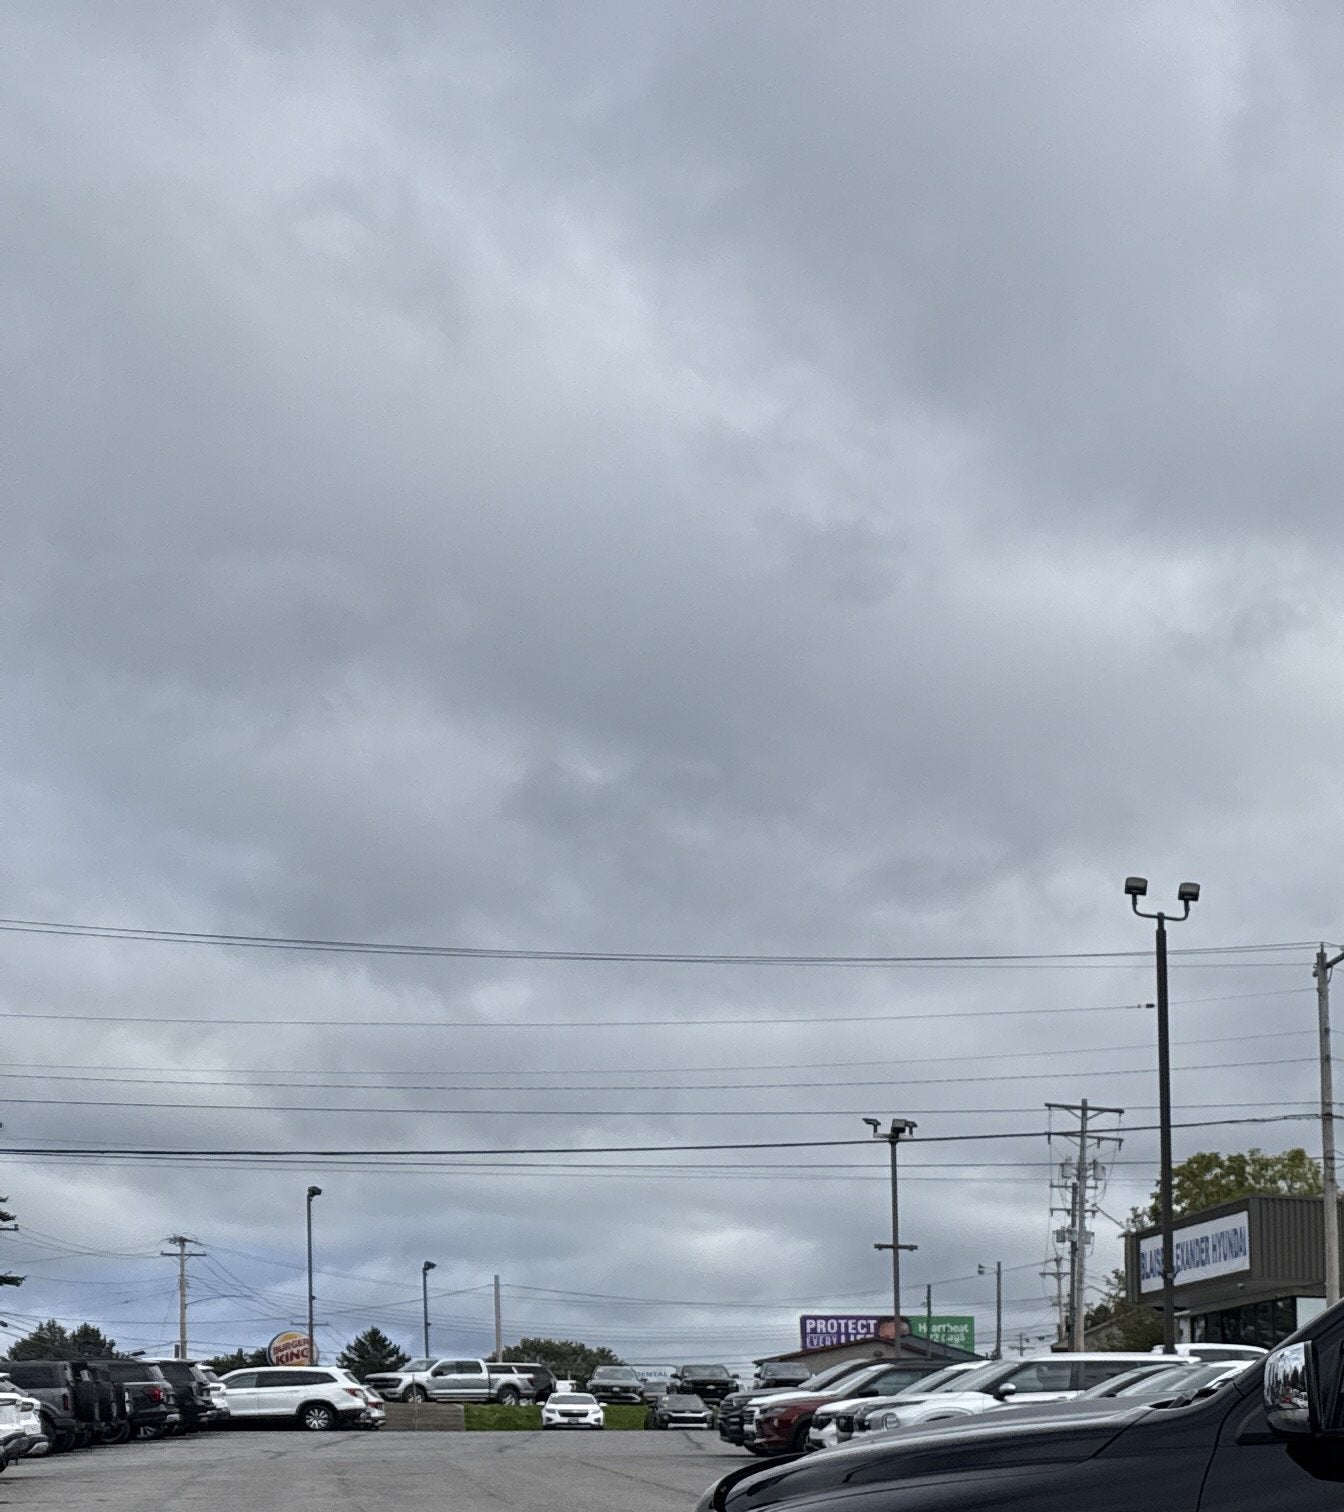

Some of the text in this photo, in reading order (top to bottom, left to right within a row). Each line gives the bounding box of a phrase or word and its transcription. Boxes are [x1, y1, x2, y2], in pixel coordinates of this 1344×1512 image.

[1174, 1236, 1211, 1271] EXANDER
[1212, 1225, 1247, 1263] HYUNDAI
[806, 1319, 877, 1334] PROTECT
[918, 1322, 968, 1333] Hartbeat
[273, 1338, 311, 1354] BURGER
[806, 1334, 837, 1349] EVERY
